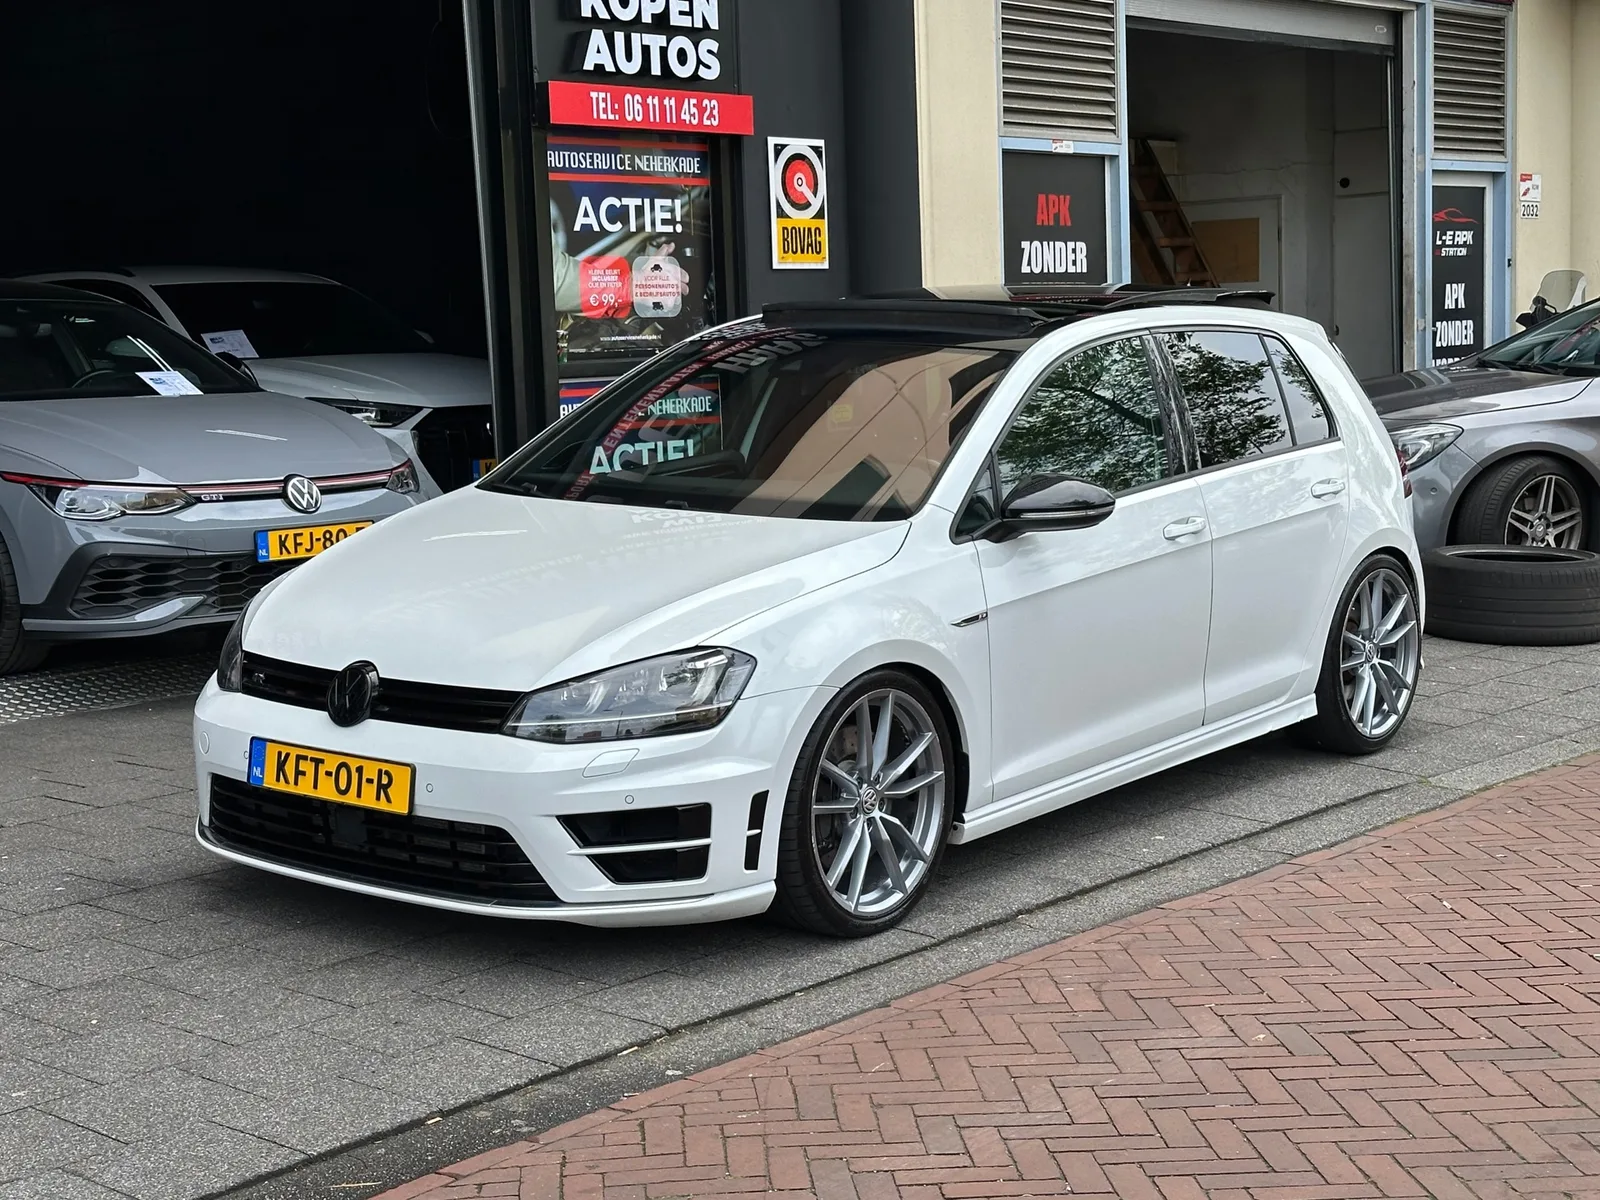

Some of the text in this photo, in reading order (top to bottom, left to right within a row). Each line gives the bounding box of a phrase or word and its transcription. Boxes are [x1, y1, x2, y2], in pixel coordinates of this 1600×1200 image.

[583, 28, 721, 80] AUTOS
[590, 91, 719, 126] TEL: 06 11 11 45 23
[547, 150, 701, 174] AUTOSERVICE NEHERKADE
[573, 196, 683, 233] ACTIE!
[1036, 194, 1072, 226] APK
[1522, 204, 1539, 217] 2032
[782, 226, 822, 255] BOVAG
[1436, 230, 1473, 245] L-E APK
[1441, 247, 1467, 257] STATION
[1021, 241, 1087, 274] ZONDER
[589, 294, 599, 307] €
[1444, 283, 1466, 309] APK
[1435, 319, 1474, 348] ZONDER
[648, 395, 712, 416] NEHERKADE
[278, 526, 366, 556] KFJ-80-
[253, 750, 394, 804] NL KFT-01-R
